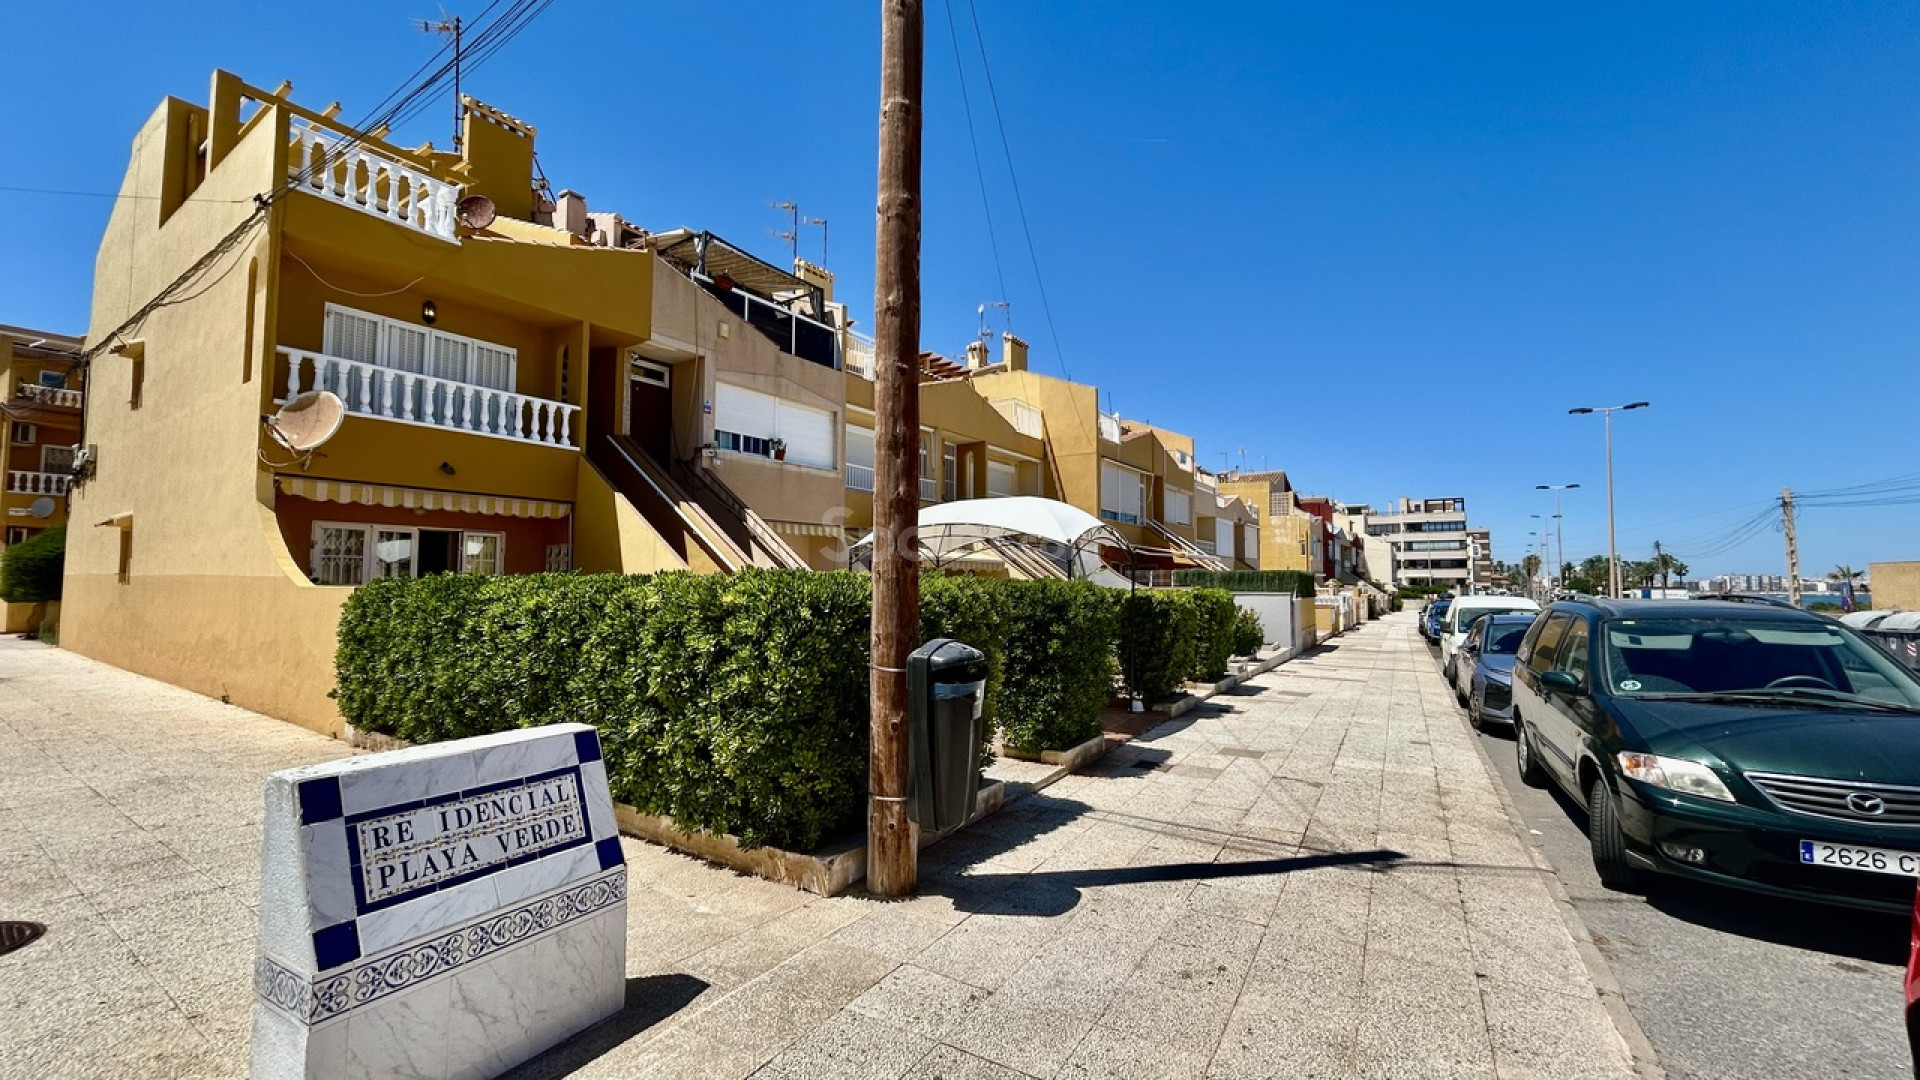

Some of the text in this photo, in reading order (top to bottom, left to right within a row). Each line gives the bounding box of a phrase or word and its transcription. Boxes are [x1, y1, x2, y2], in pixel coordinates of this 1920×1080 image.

[378, 814, 577, 890] PLAYA VERDE
[1822, 845, 1920, 874] 2626 C
